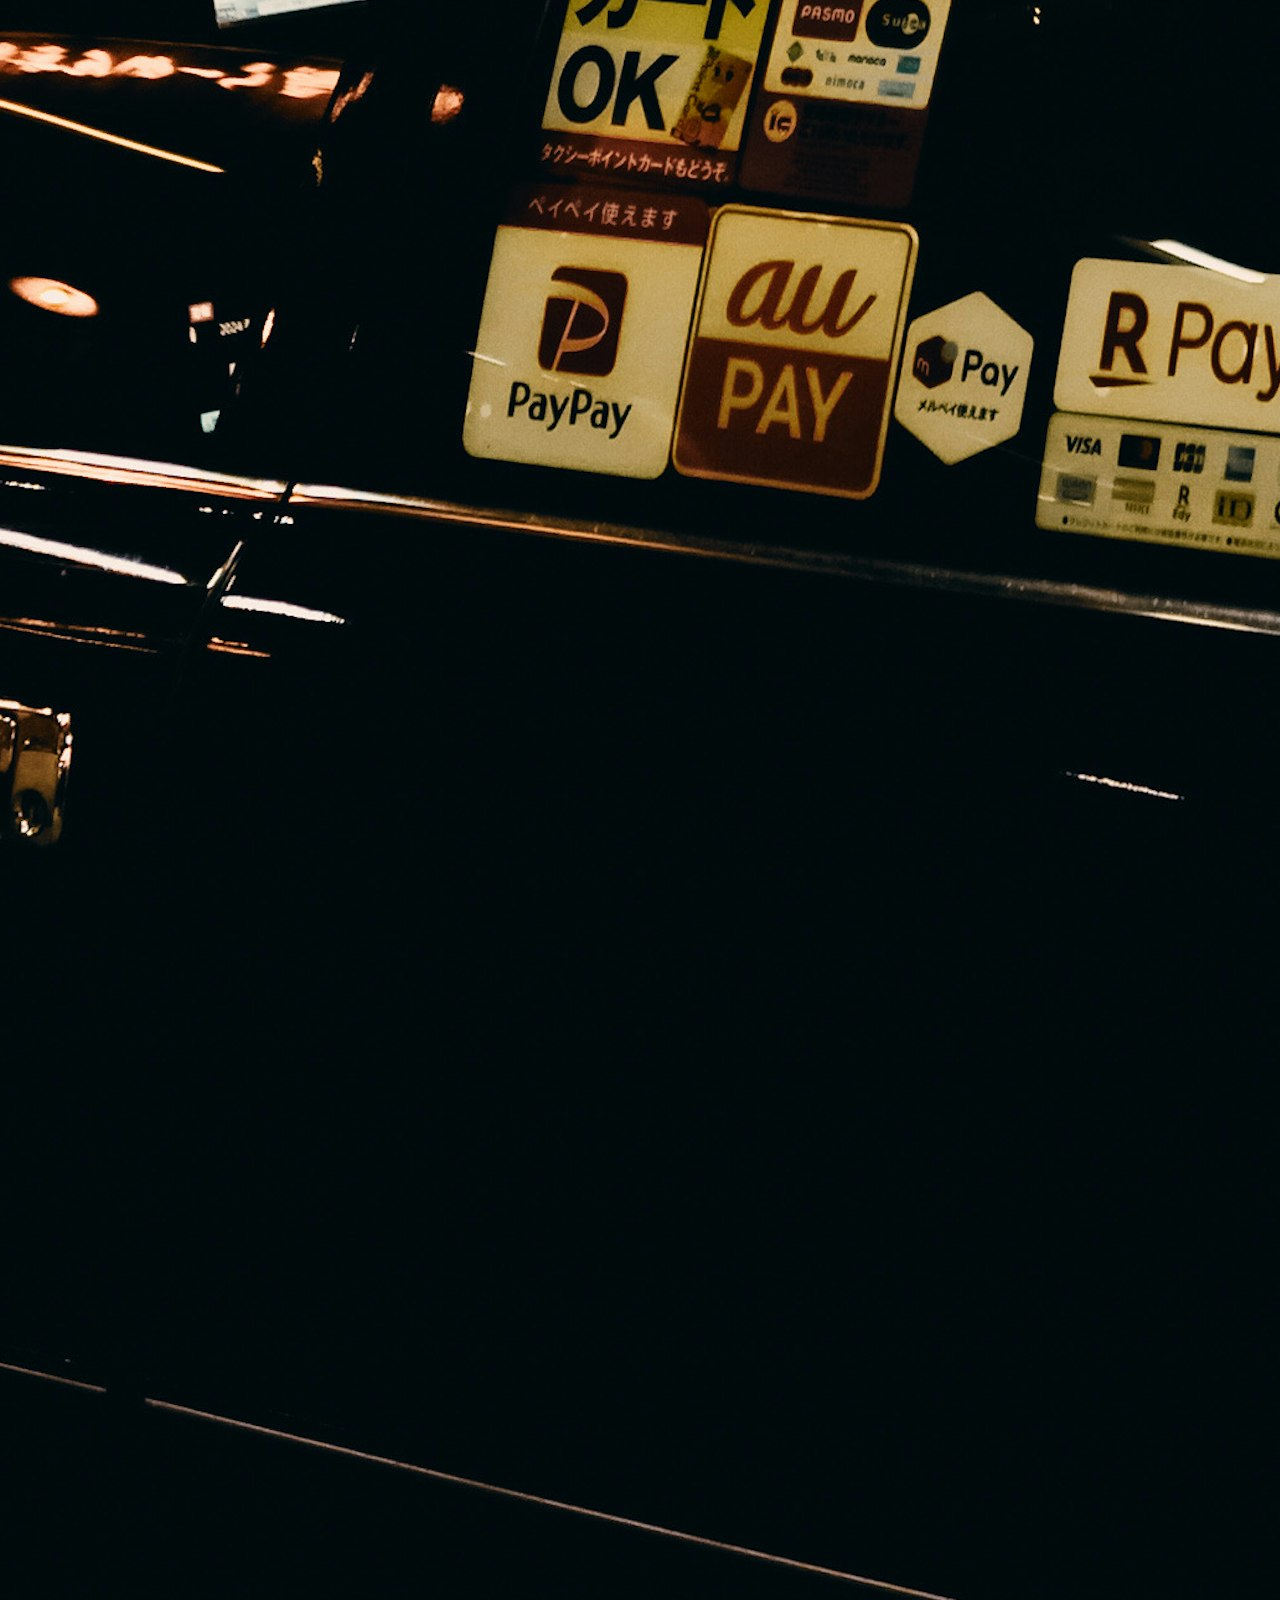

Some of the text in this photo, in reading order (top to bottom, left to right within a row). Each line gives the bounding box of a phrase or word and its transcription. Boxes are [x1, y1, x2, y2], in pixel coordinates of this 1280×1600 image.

[801, 4, 927, 33] PASMO Suica
[557, 44, 679, 131] OK
[527, 195, 678, 231] ペイペイ使えます
[726, 258, 878, 338] au
[961, 349, 1019, 397] Pay
[507, 381, 632, 440] PayPay
[717, 357, 853, 443] PAY
[1066, 435, 1102, 457] VISA
